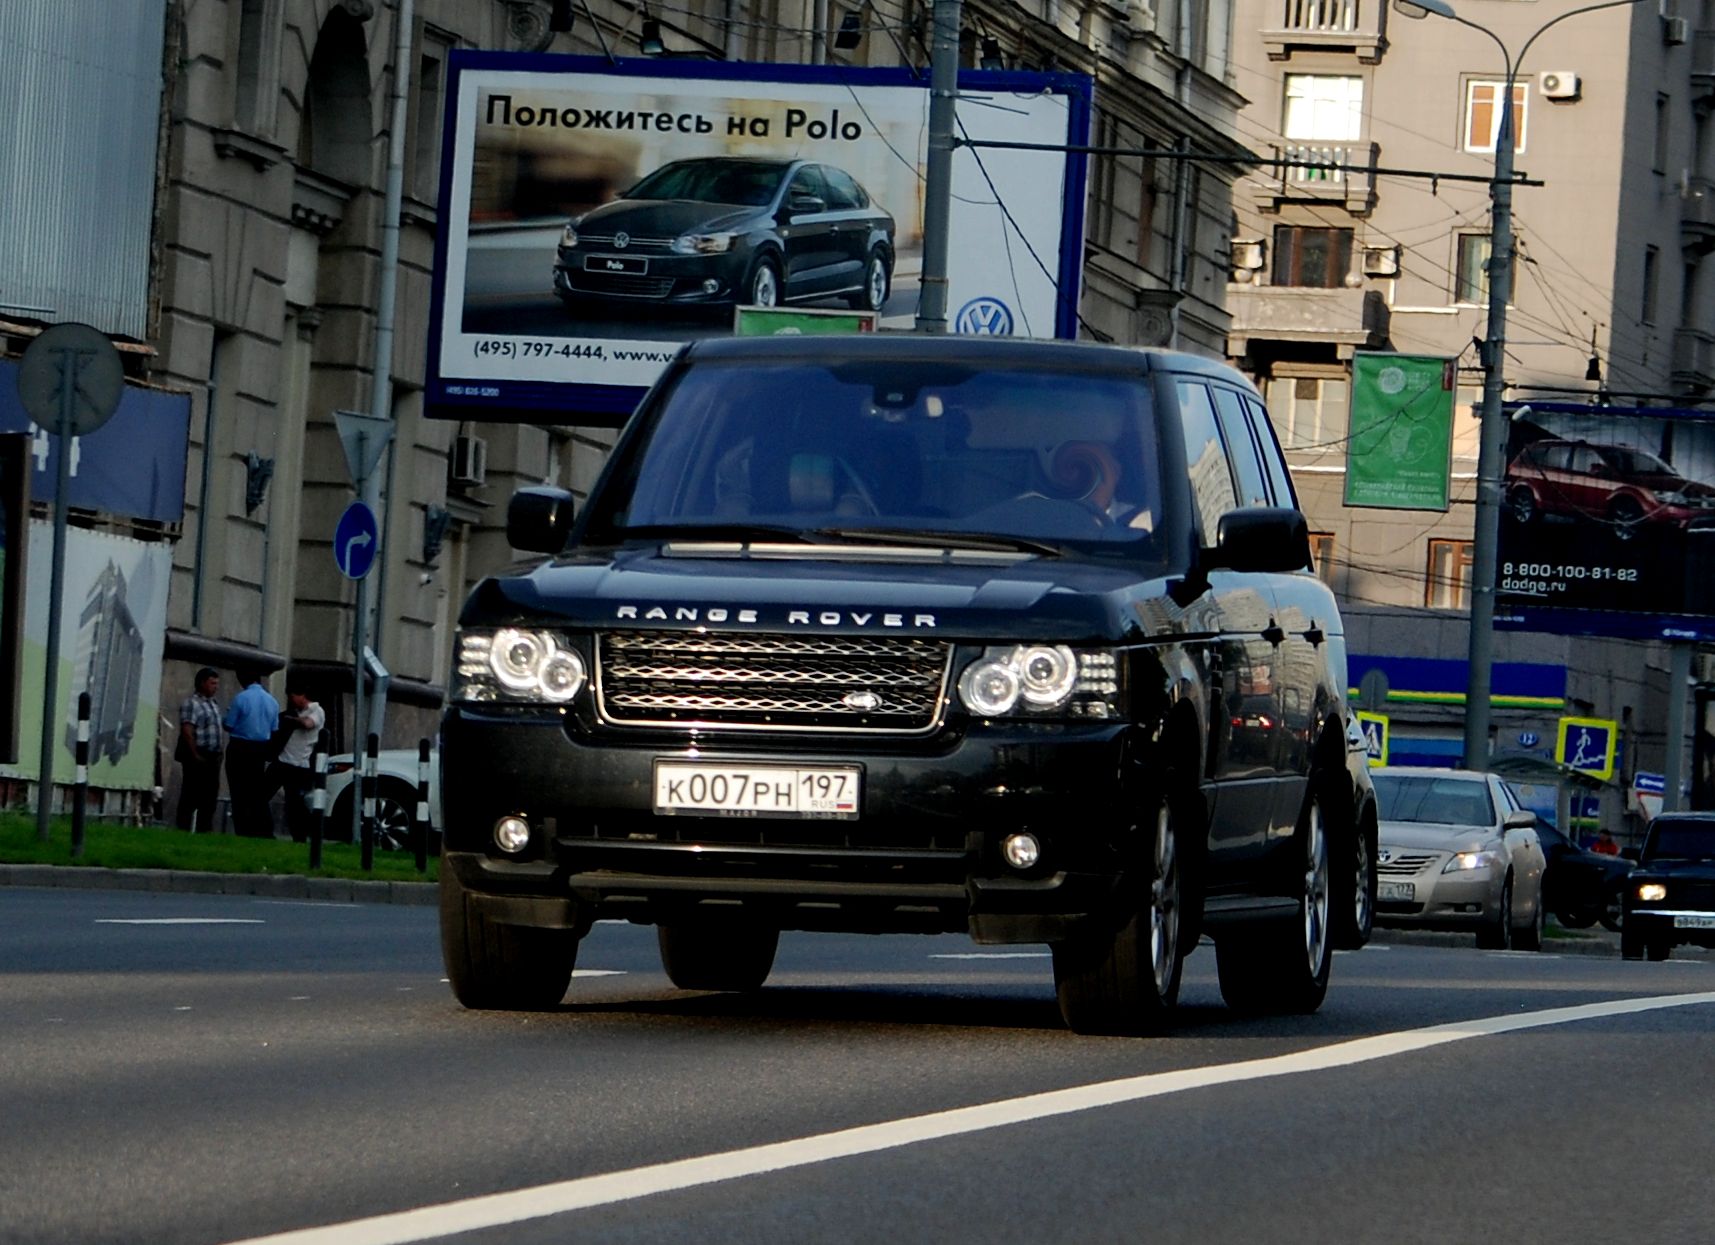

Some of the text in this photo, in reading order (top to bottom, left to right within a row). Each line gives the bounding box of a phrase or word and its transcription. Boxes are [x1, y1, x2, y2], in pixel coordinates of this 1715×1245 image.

[486, 95, 862, 140] Положитесь на Polo
[473, 341, 517, 359] (495)
[523, 342, 608, 361] 797-4444,
[1503, 562, 1638, 582] 8-800-100-81-82
[1502, 578, 1567, 594] dodge.ru
[617, 606, 937, 628] RANGE ROVER
[668, 774, 848, 806] К007РН 197
[811, 801, 836, 809] RUS
